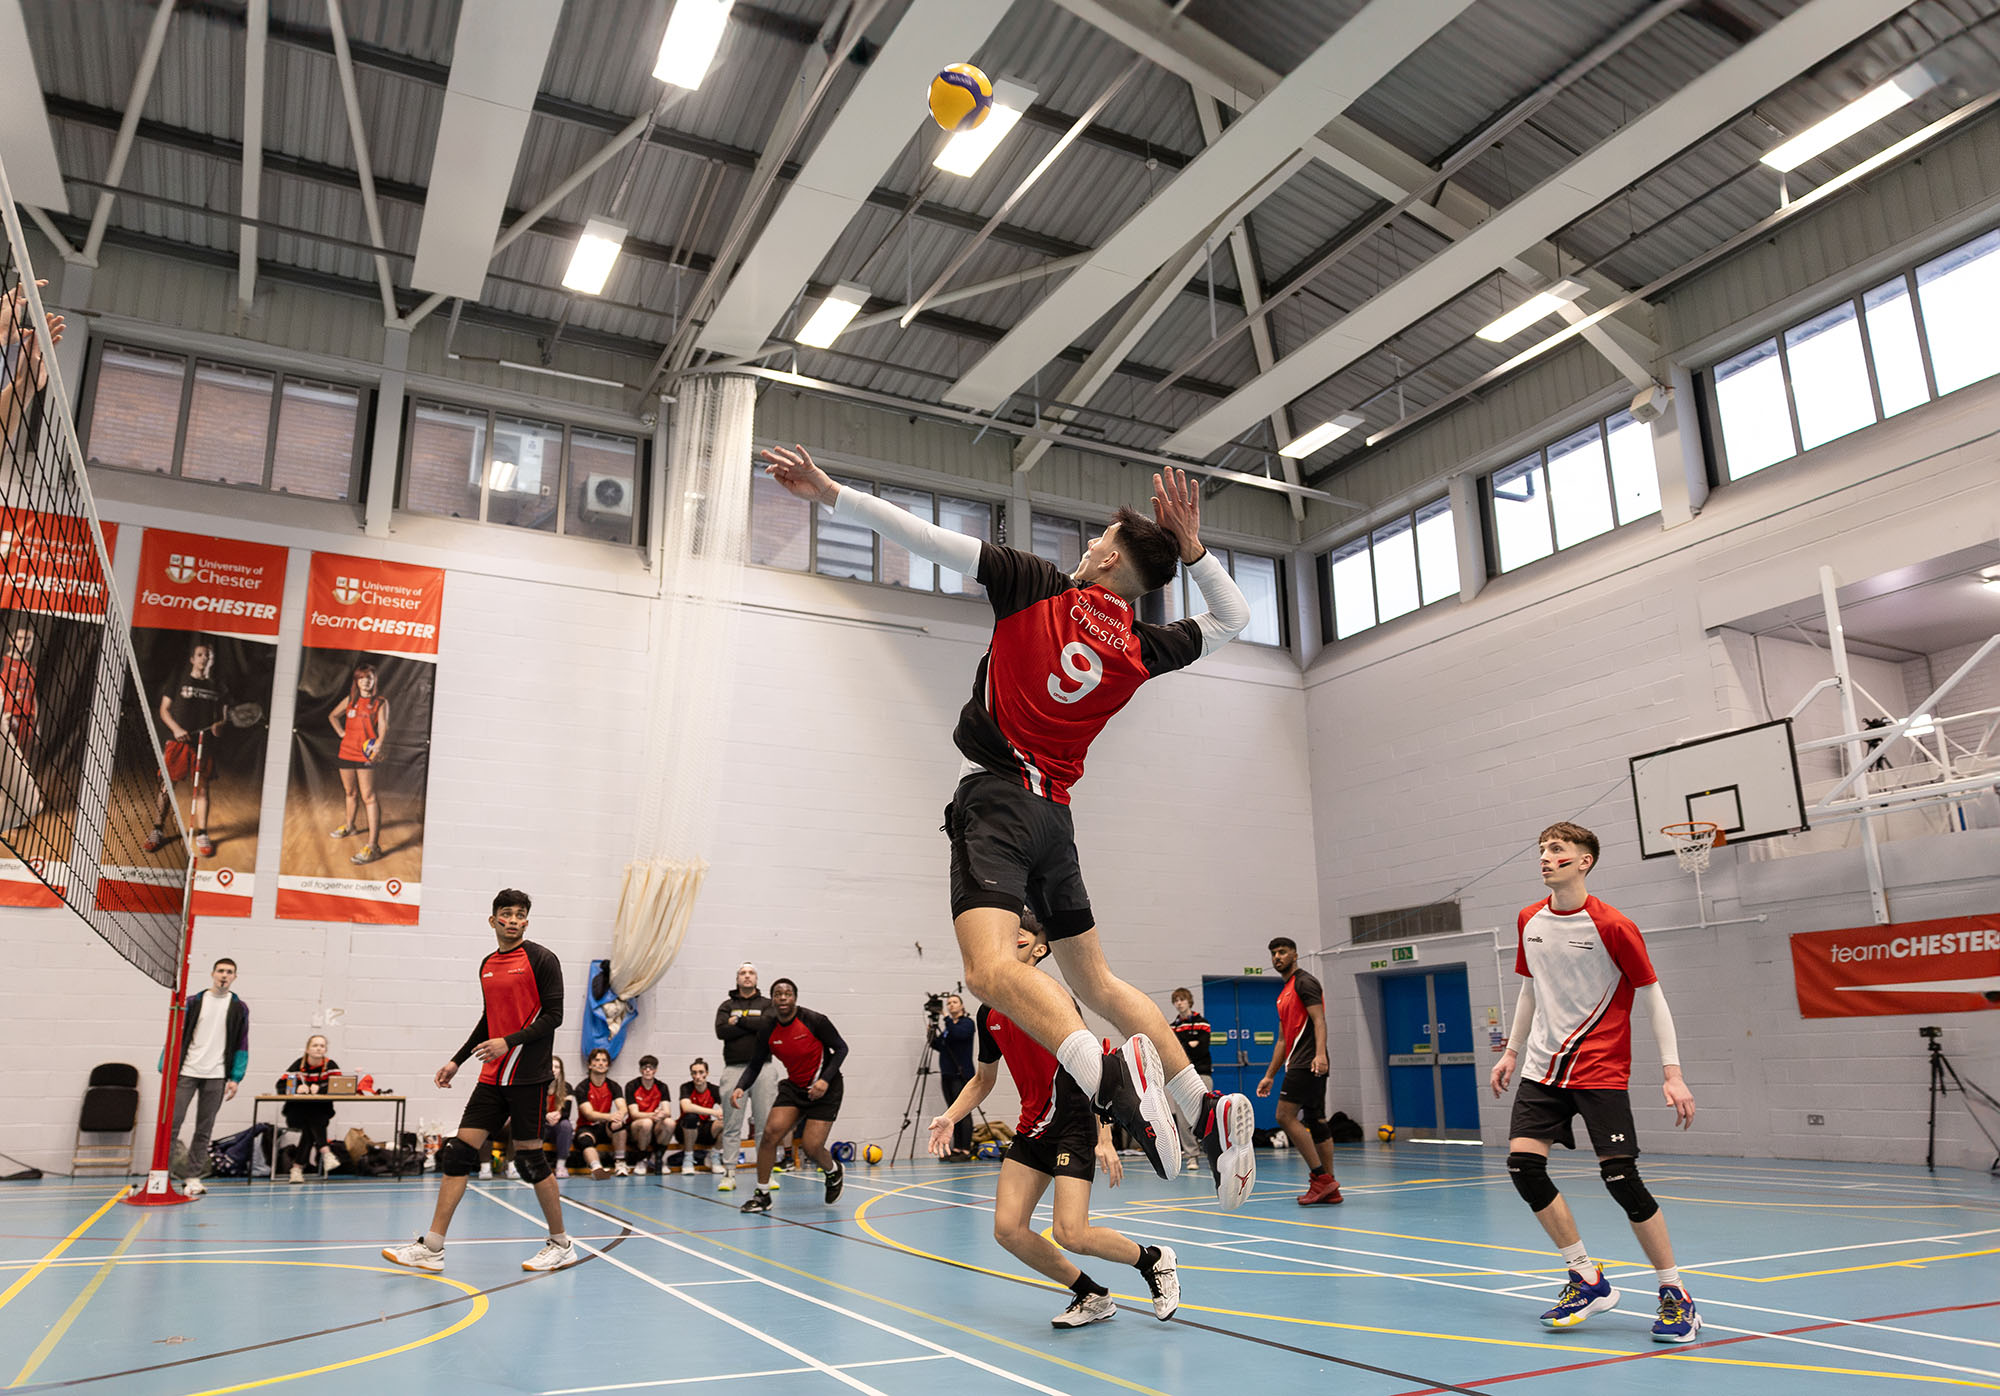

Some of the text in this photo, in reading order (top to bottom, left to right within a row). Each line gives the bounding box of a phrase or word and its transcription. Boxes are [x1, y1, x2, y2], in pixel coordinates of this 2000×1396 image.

[196, 569, 263, 590] Chester
[198, 558, 264, 576] University of
[361, 590, 422, 610] Chester
[362, 580, 423, 597] University of
[141, 589, 277, 620] teamCHESTER
[1077, 595, 1127, 632] University
[311, 610, 436, 639] teamCHESTER
[1070, 604, 1129, 652] Chester
[1047, 641, 1103, 704] 9
[301, 881, 382, 892] all together better
[1831, 930, 1999, 963] teamCHESTER
[1056, 1153, 1071, 1167] 15
